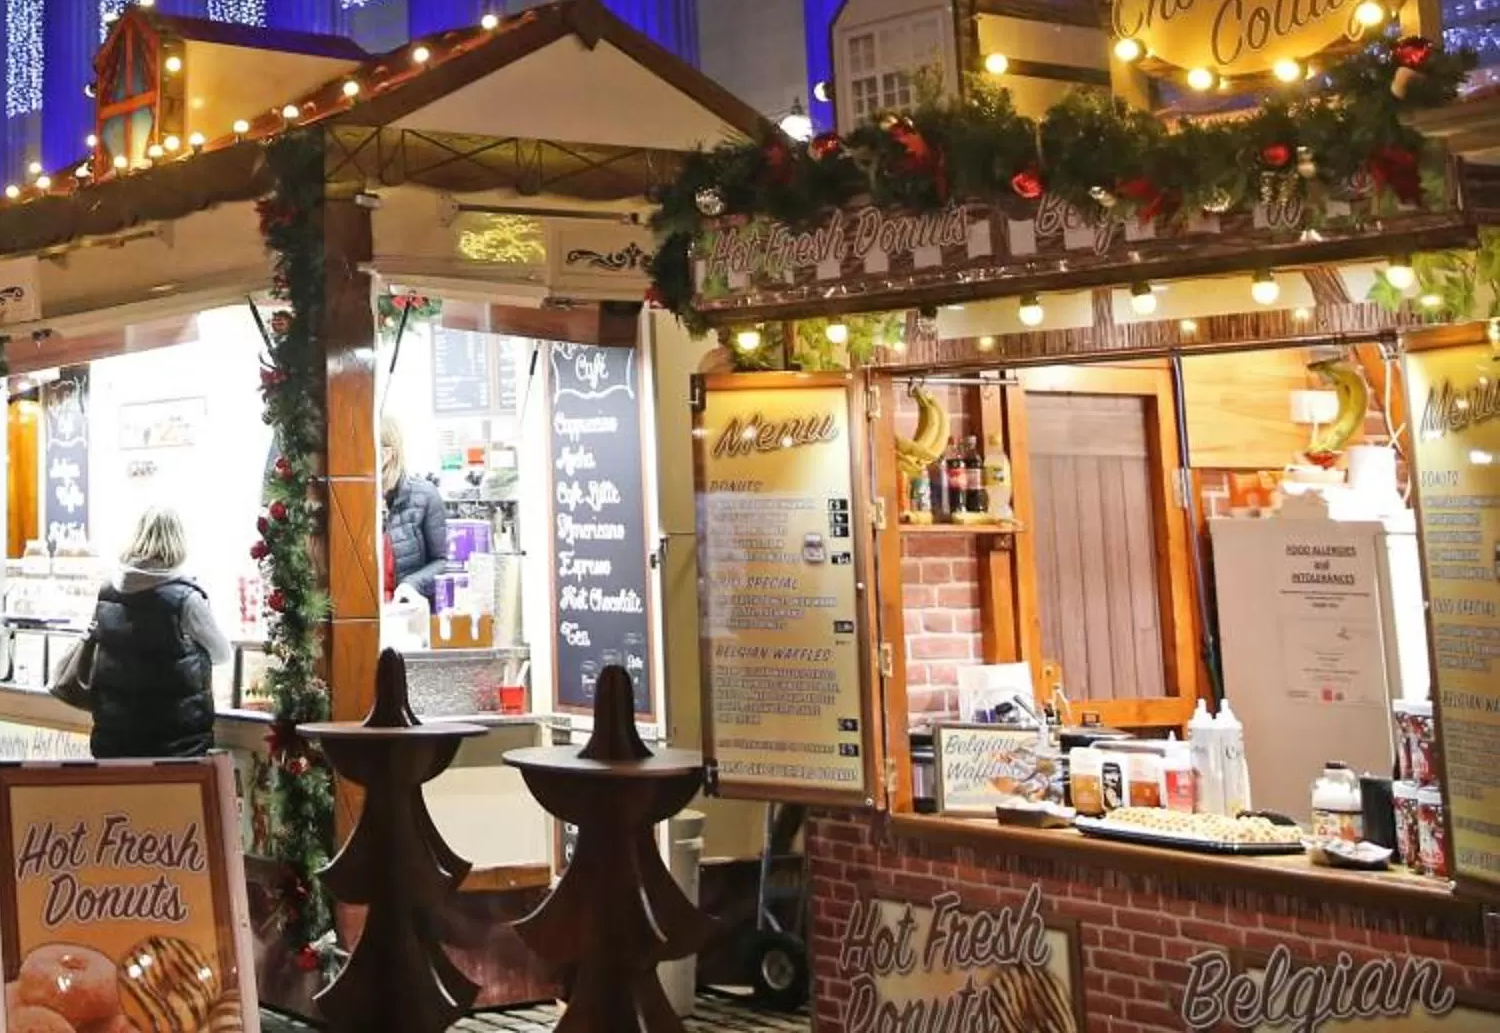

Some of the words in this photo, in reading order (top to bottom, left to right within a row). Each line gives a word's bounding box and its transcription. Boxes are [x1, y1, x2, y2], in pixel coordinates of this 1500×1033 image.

[707, 227, 761, 275] Hot
[765, 208, 848, 268] Fresh
[852, 205, 968, 259] Donuts
[711, 410, 840, 460] Menu
[560, 584, 588, 612] Hot
[17, 820, 89, 880] Hot
[96, 814, 206, 873] Fresh
[44, 873, 189, 927] Donuts
[838, 898, 918, 977] Hot
[923, 881, 1051, 968] Fresh
[1181, 943, 1456, 1033] Belgian
